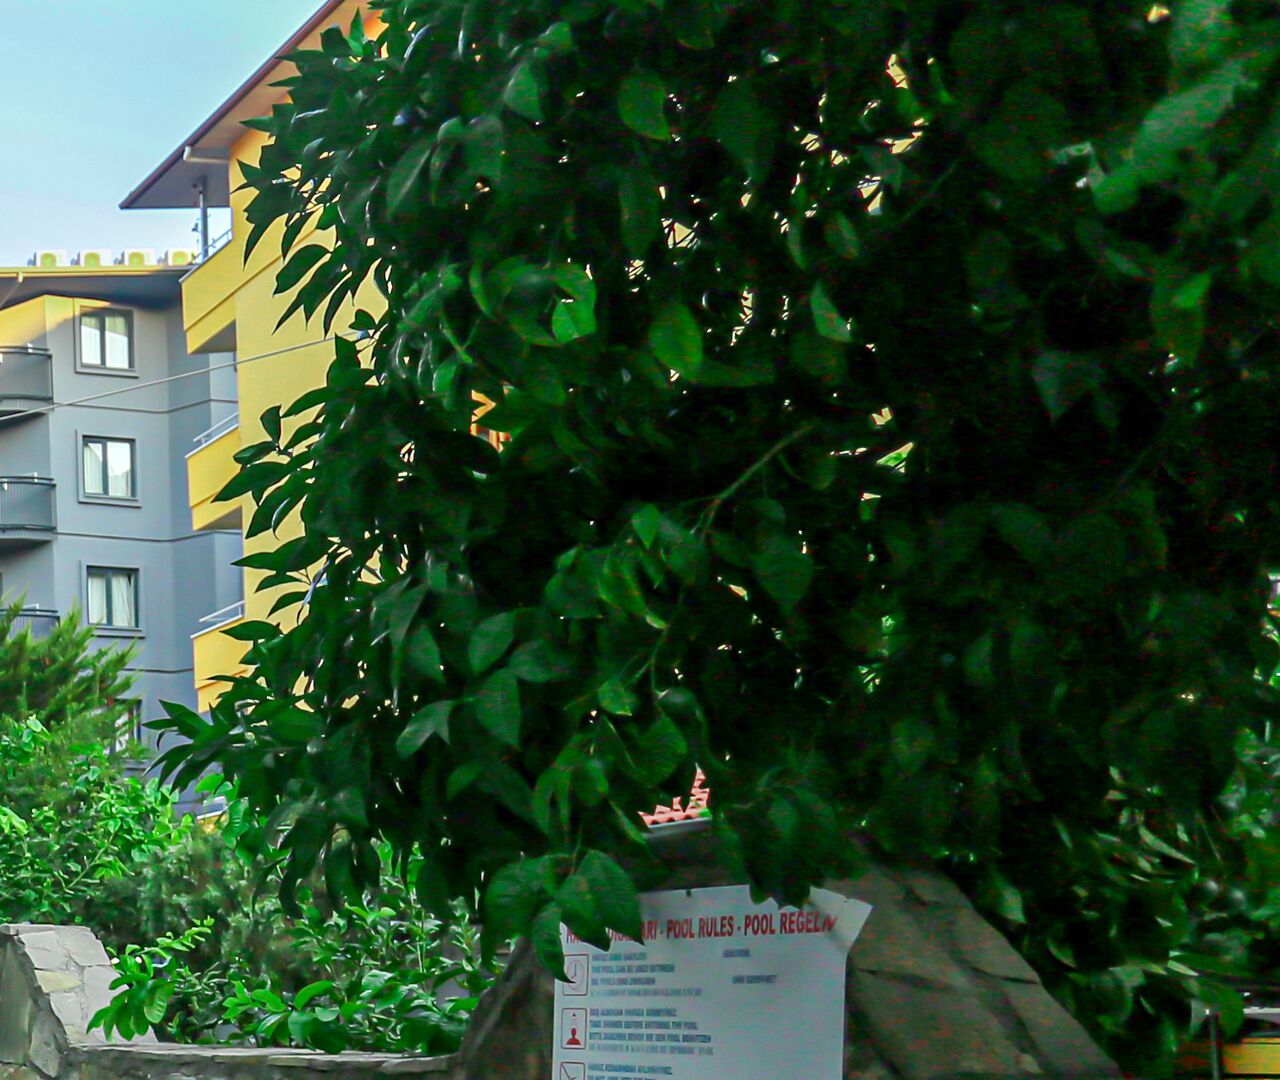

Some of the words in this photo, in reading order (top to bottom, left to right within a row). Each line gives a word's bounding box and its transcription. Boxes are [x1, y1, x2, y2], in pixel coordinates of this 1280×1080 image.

[667, 919, 695, 939] POOL
[698, 916, 734, 937] RULES
[744, 914, 776, 936] POOL
